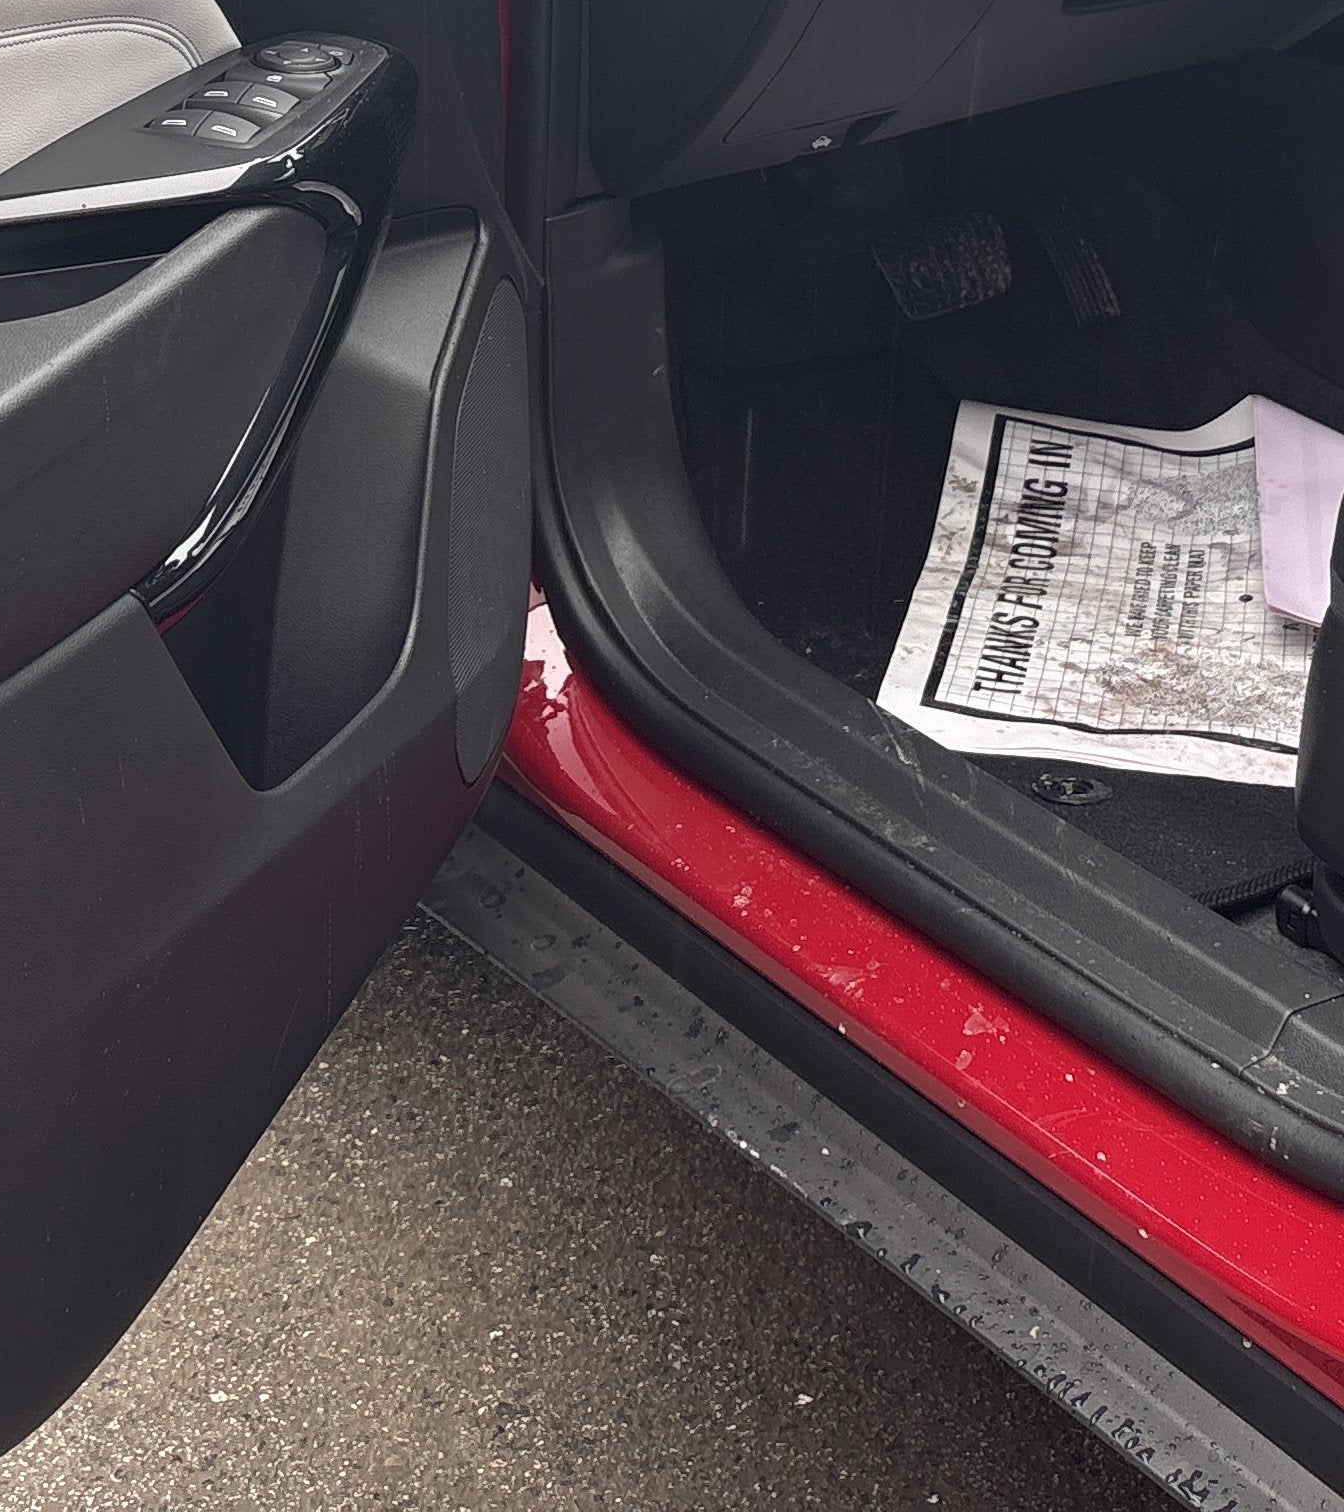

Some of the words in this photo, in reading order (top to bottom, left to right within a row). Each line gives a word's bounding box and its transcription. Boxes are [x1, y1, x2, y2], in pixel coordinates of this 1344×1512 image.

[1028, 439, 1074, 469] IN
[1008, 478, 1069, 571] COMING
[1138, 541, 1157, 565] KEEP
[1162, 544, 1182, 572] CLEAN
[1136, 566, 1154, 576] TO
[1183, 571, 1204, 598] PAPER
[997, 575, 1051, 610] FOR
[972, 612, 1040, 694] THANKS
